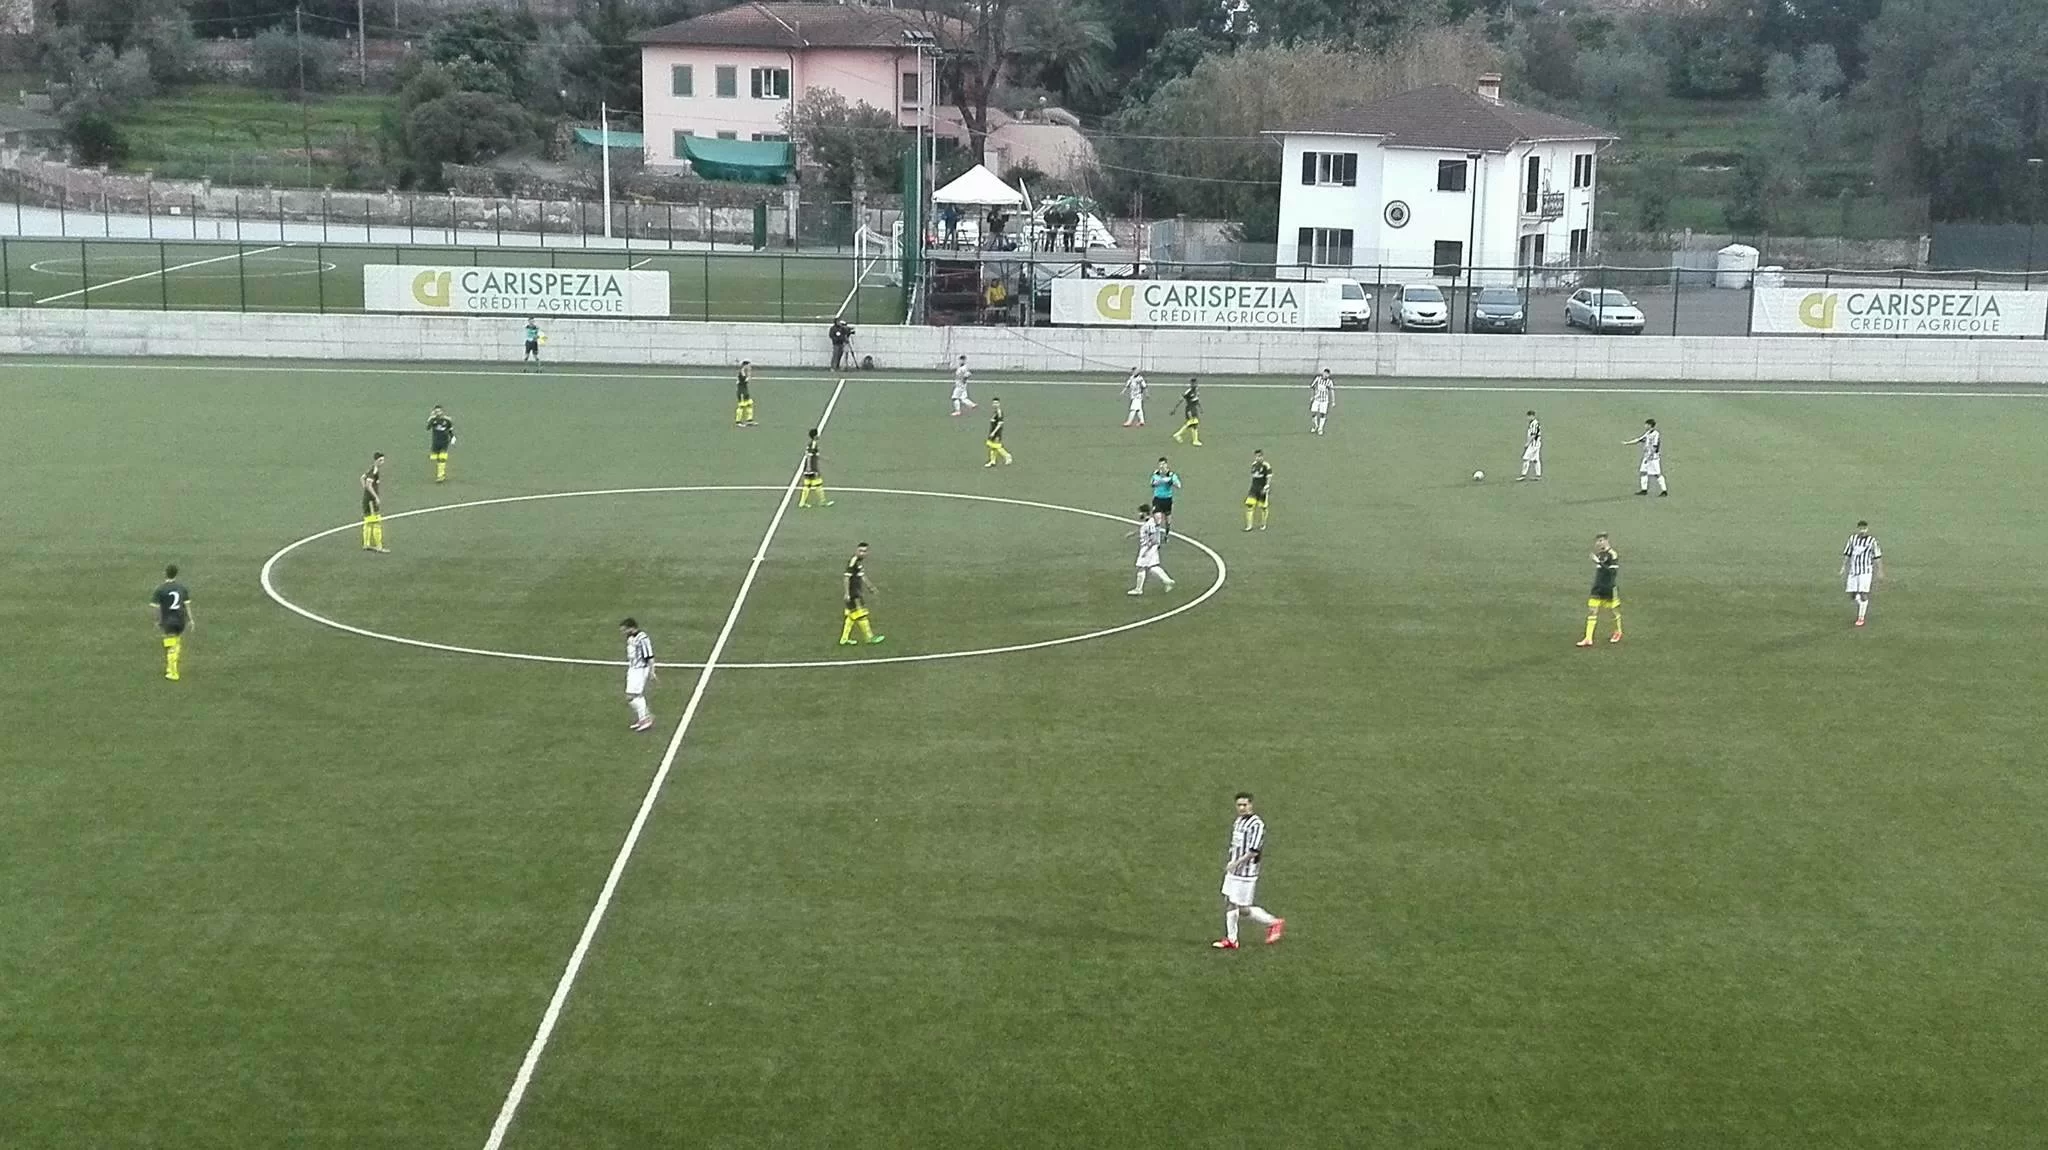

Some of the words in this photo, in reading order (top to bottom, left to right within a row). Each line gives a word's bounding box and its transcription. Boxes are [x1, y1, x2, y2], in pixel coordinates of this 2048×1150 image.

[461, 271, 623, 297] CARISPEZIA
[537, 298, 623, 312] AGRICOLE
[1144, 285, 1299, 308] CARISPEZIA
[1847, 293, 2001, 317] CARISPEZIA
[1215, 310, 1299, 324] AGRICOLE
[1916, 319, 2000, 332] AGRICOLE
[168, 591, 181, 610] 2
